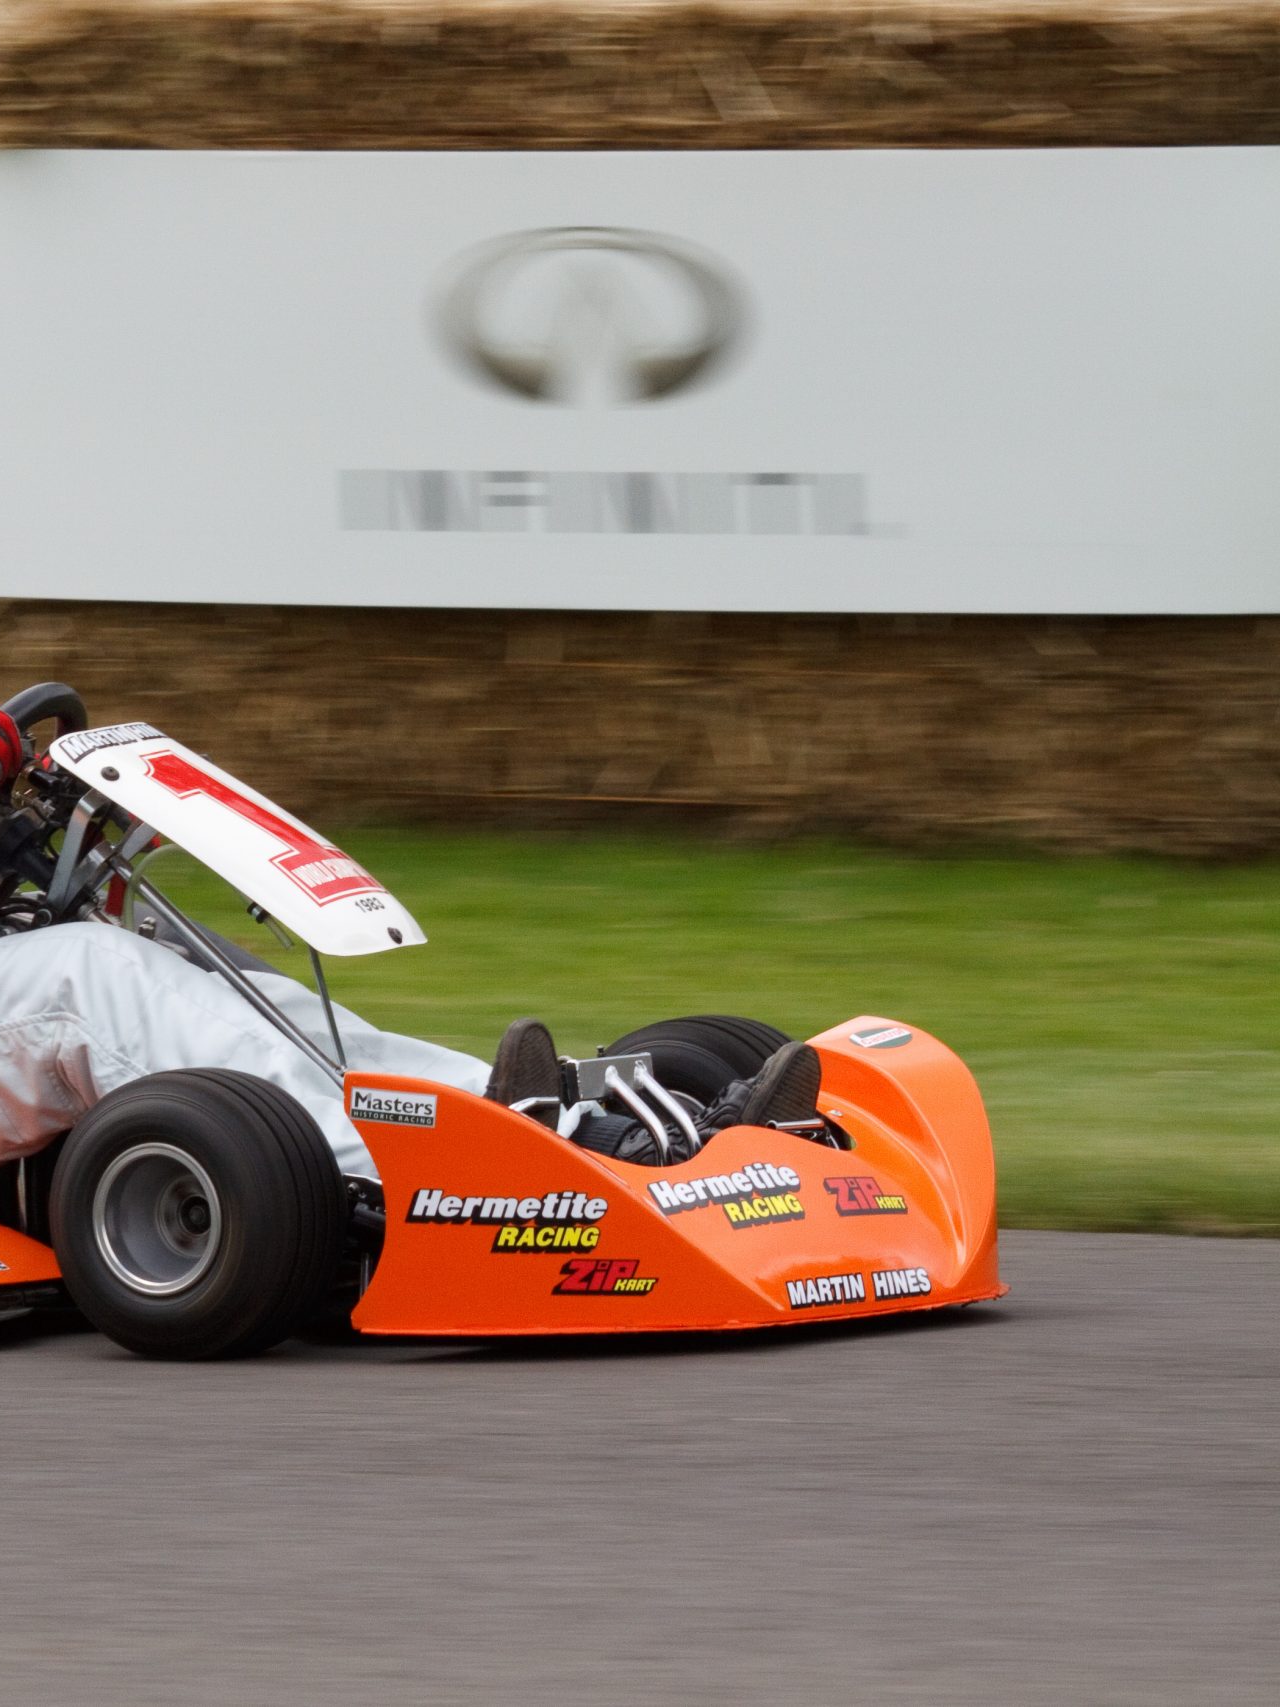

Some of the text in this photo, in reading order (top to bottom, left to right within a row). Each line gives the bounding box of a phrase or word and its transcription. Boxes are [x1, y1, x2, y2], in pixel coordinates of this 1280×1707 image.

[138, 749, 390, 908] 1
[354, 897, 386, 913] 1983
[355, 1091, 433, 1116] Masters
[353, 1110, 433, 1125] HISTORIC RACING
[648, 1162, 801, 1211] Hermetite
[408, 1188, 608, 1222] Hermetite
[724, 1192, 804, 1225] RACING
[874, 1196, 907, 1211] KART
[495, 1226, 600, 1250] RACING
[614, 1278, 658, 1292] KART
[786, 1268, 932, 1309] MARTIN HINES
